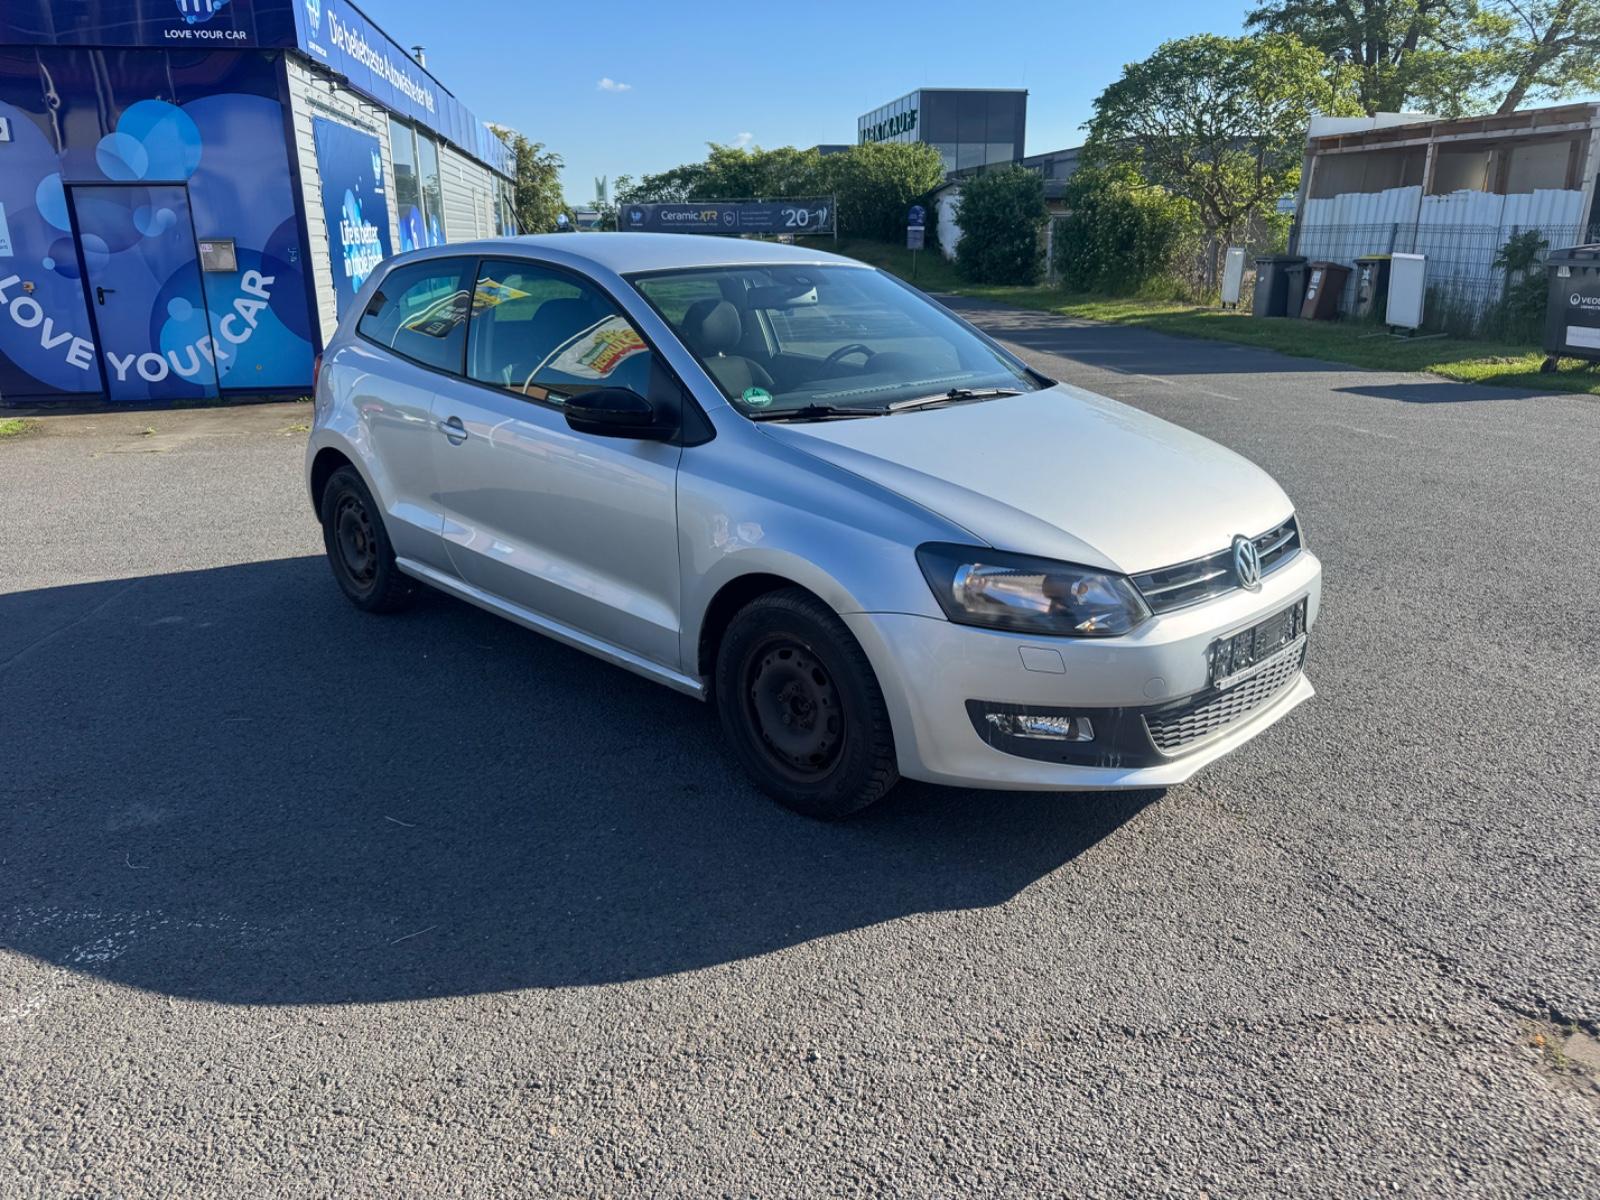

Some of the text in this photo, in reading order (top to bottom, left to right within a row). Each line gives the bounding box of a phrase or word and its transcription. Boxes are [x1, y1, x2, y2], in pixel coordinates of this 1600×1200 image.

[164, 29, 247, 40] LOVE YOUR CAR
[327, 9, 345, 51] Die
[660, 210, 698, 221] Ceramic
[0, 269, 275, 382] LOVE YOUR CAR
